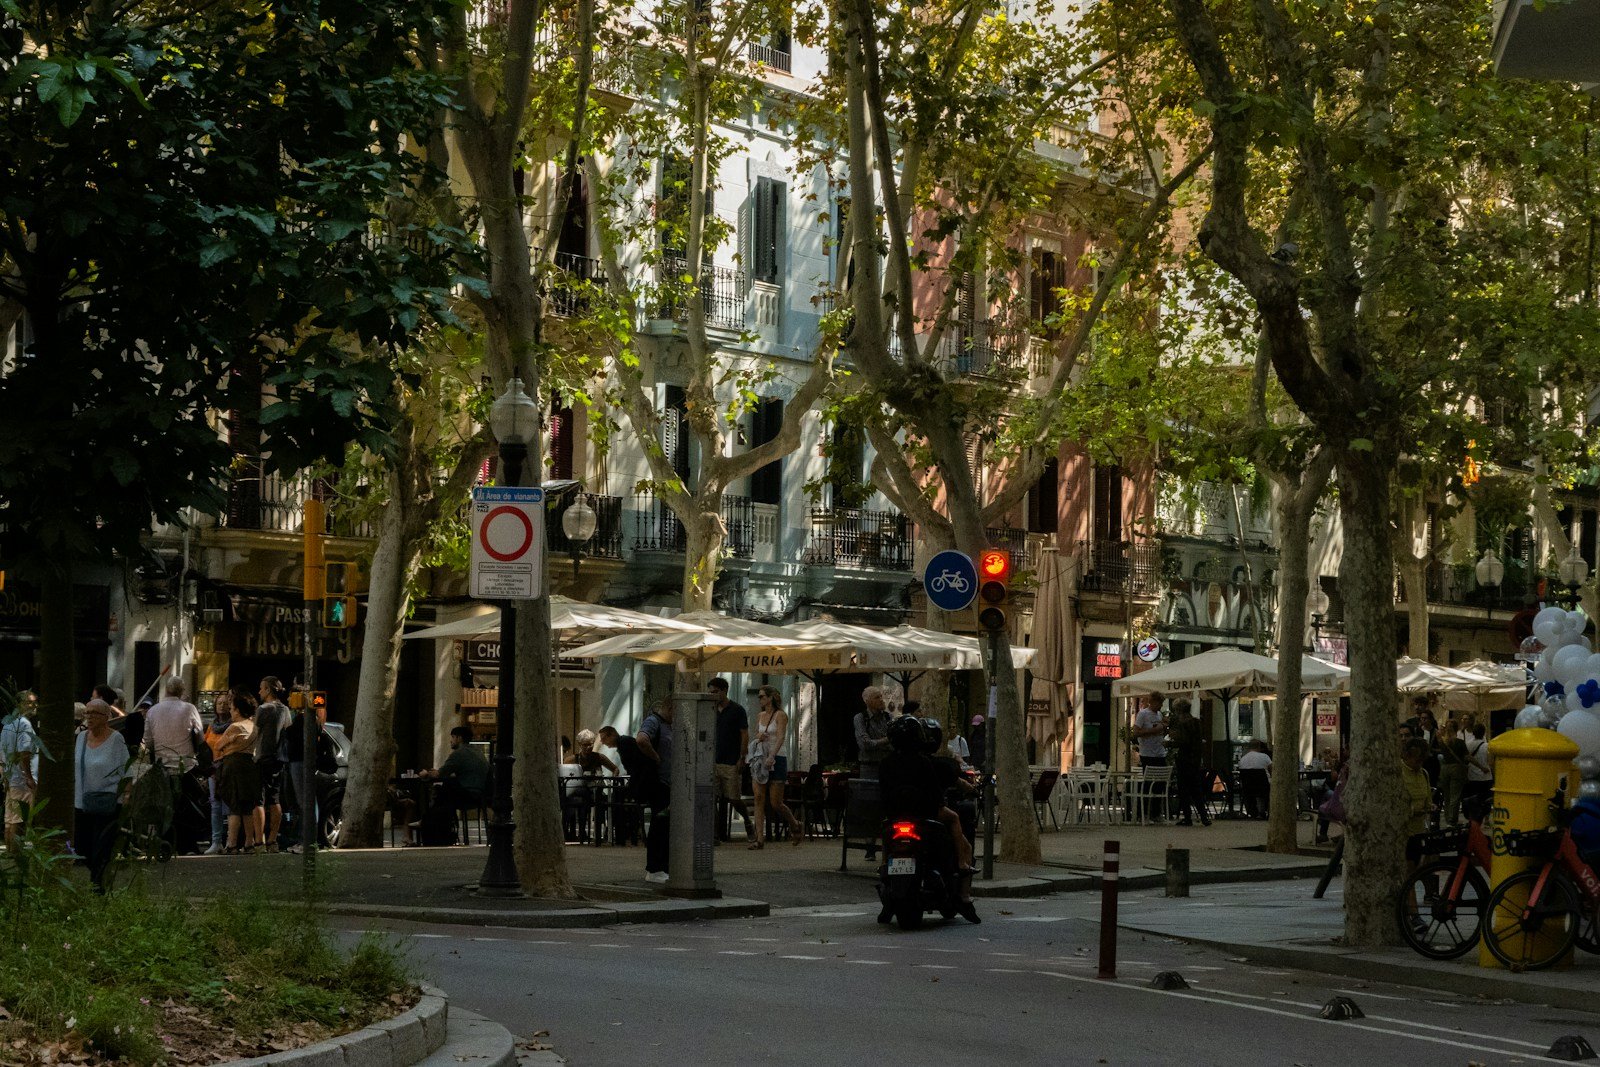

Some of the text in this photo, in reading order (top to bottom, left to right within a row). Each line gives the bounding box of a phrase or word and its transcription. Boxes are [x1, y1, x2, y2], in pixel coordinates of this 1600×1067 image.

[502, 493, 512, 501] de
[743, 655, 784, 667] TURIA
[891, 652, 918, 665] TURIA
[1166, 681, 1201, 691] TURIA
